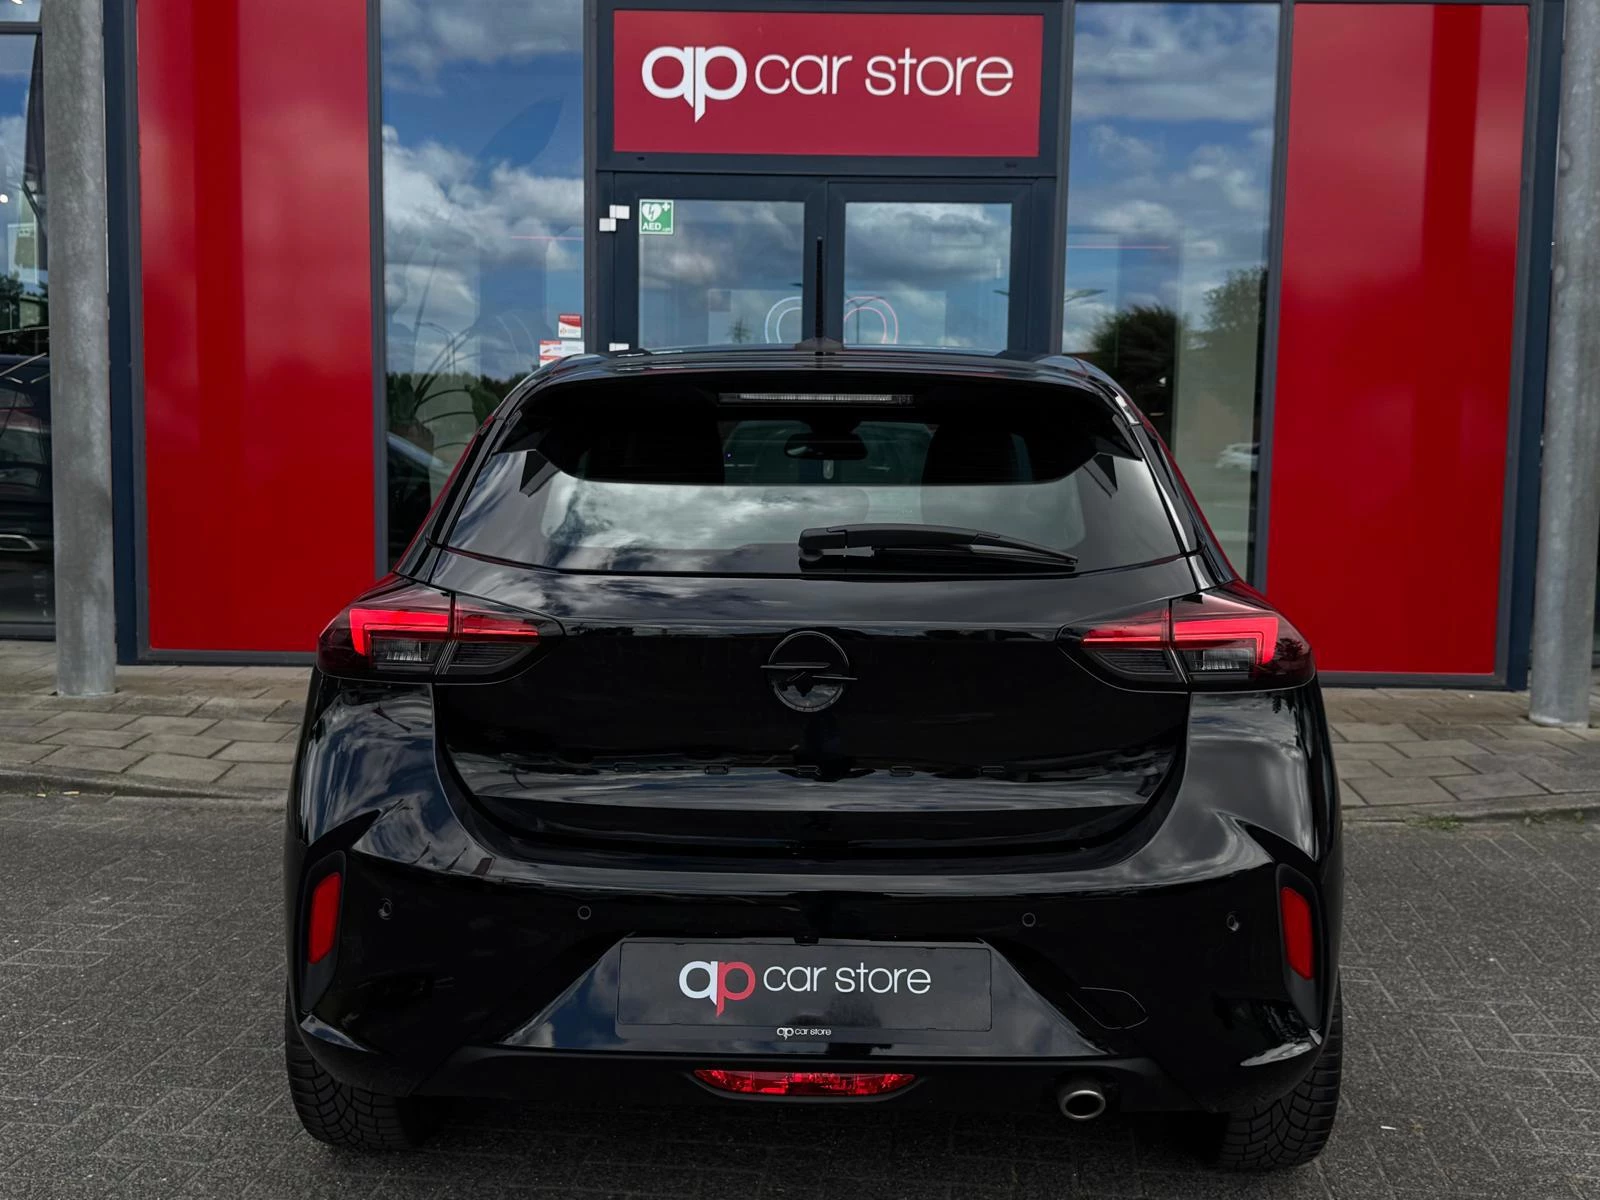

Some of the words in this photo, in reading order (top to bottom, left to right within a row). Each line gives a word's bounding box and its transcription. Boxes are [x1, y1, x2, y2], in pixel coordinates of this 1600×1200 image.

[754, 54, 853, 96] car
[864, 47, 1014, 97] store
[642, 222, 662, 231] AED
[763, 965, 828, 993] car
[834, 961, 932, 995] store
[795, 1028, 809, 1036] car
[810, 1028, 832, 1036] store
